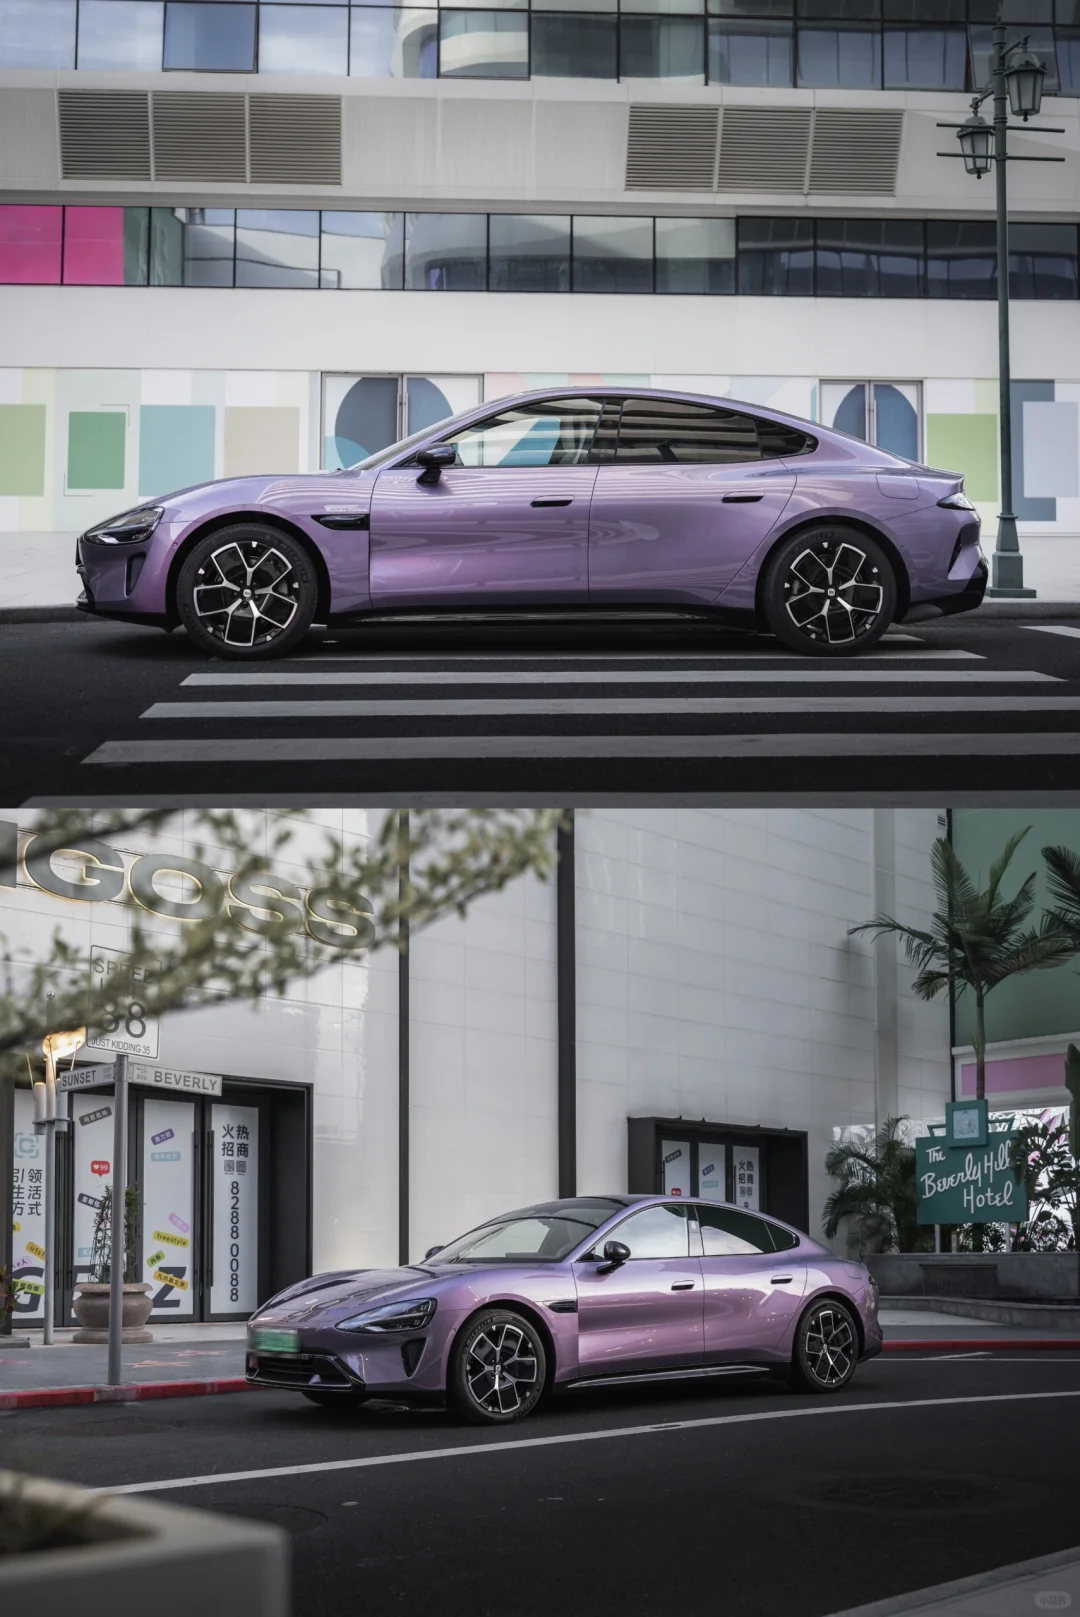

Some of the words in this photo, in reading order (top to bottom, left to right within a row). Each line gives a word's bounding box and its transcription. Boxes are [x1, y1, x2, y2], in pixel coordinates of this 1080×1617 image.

[93, 958, 153, 984] SPED
[91, 1037, 110, 1047] JUST
[111, 1040, 141, 1053] KIDDING
[142, 1046, 151, 1055] 35
[62, 1070, 96, 1087] SUNSET
[153, 1071, 218, 1091] BEVERLY
[222, 1124, 250, 1140] 火热
[221, 1141, 249, 1158] 招商
[926, 1146, 946, 1163] The
[13, 1168, 43, 1183] 引领
[920, 1152, 982, 1199] Beverly
[984, 1139, 1012, 1183] Hill
[13, 1184, 43, 1200] 生活
[963, 1180, 1013, 1214] Hotel
[12, 1201, 43, 1216] 方式
[156, 1233, 187, 1246] freestyle
